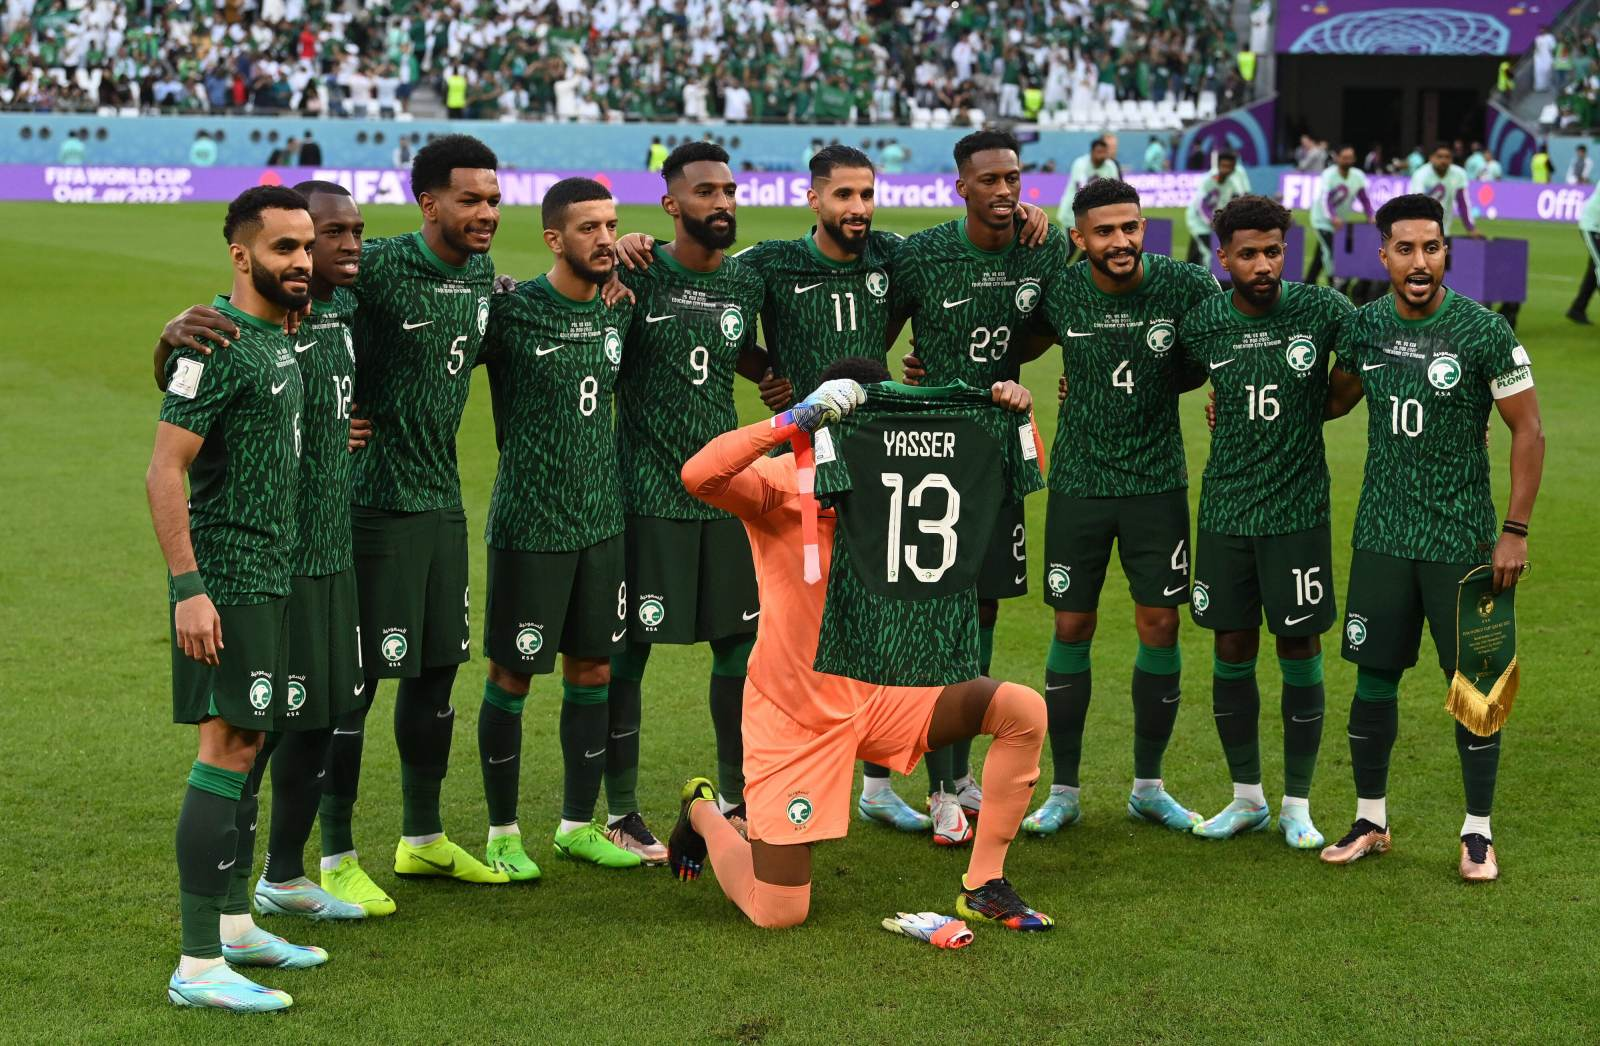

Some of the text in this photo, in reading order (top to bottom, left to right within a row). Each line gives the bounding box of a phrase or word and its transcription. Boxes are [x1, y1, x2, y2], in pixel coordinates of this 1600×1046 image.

[86, 167, 153, 185] WORLD
[155, 168, 192, 185] CUP
[735, 177, 785, 206] cial
[1536, 188, 1586, 220] Offi
[831, 292, 856, 331] 11
[447, 335, 468, 374] 5
[969, 326, 1011, 362] 23
[690, 346, 708, 385] 9
[1112, 360, 1134, 394] 4
[332, 375, 352, 420] 12
[580, 375, 598, 416] 8
[1245, 384, 1280, 420] 16
[294, 411, 301, 458] 6
[1389, 395, 1423, 437] 10
[884, 430, 955, 458] YASSER
[881, 472, 961, 583] 13
[1012, 523, 1026, 561] 2
[1171, 539, 1188, 576] 4
[617, 580, 627, 620] 8
[1292, 566, 1323, 606] 16
